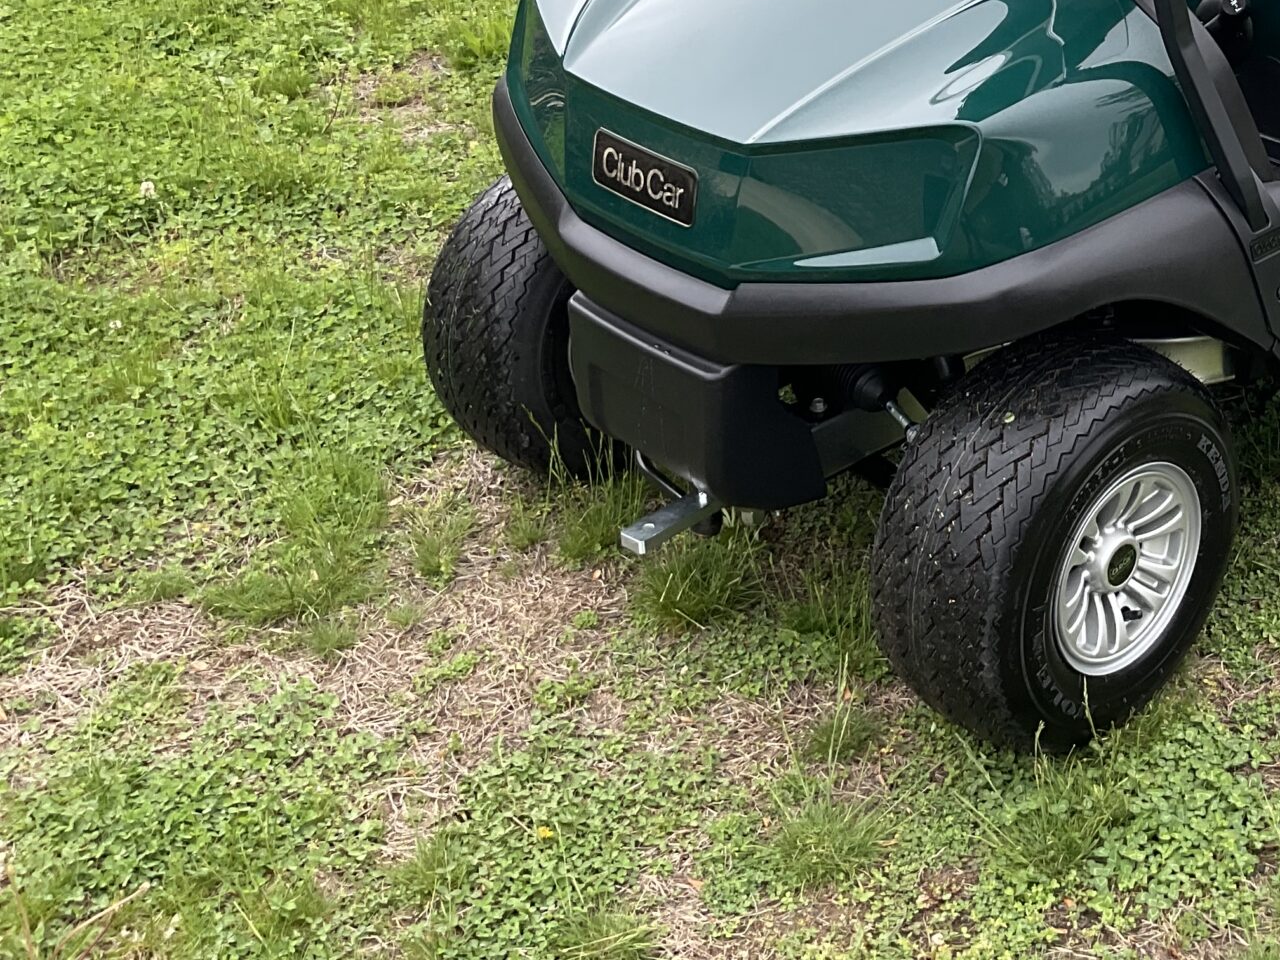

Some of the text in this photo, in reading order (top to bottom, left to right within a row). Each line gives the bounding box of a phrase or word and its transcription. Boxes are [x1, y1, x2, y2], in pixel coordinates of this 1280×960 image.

[603, 147, 685, 209] Club Car
[1197, 433, 1231, 513] KENDA
